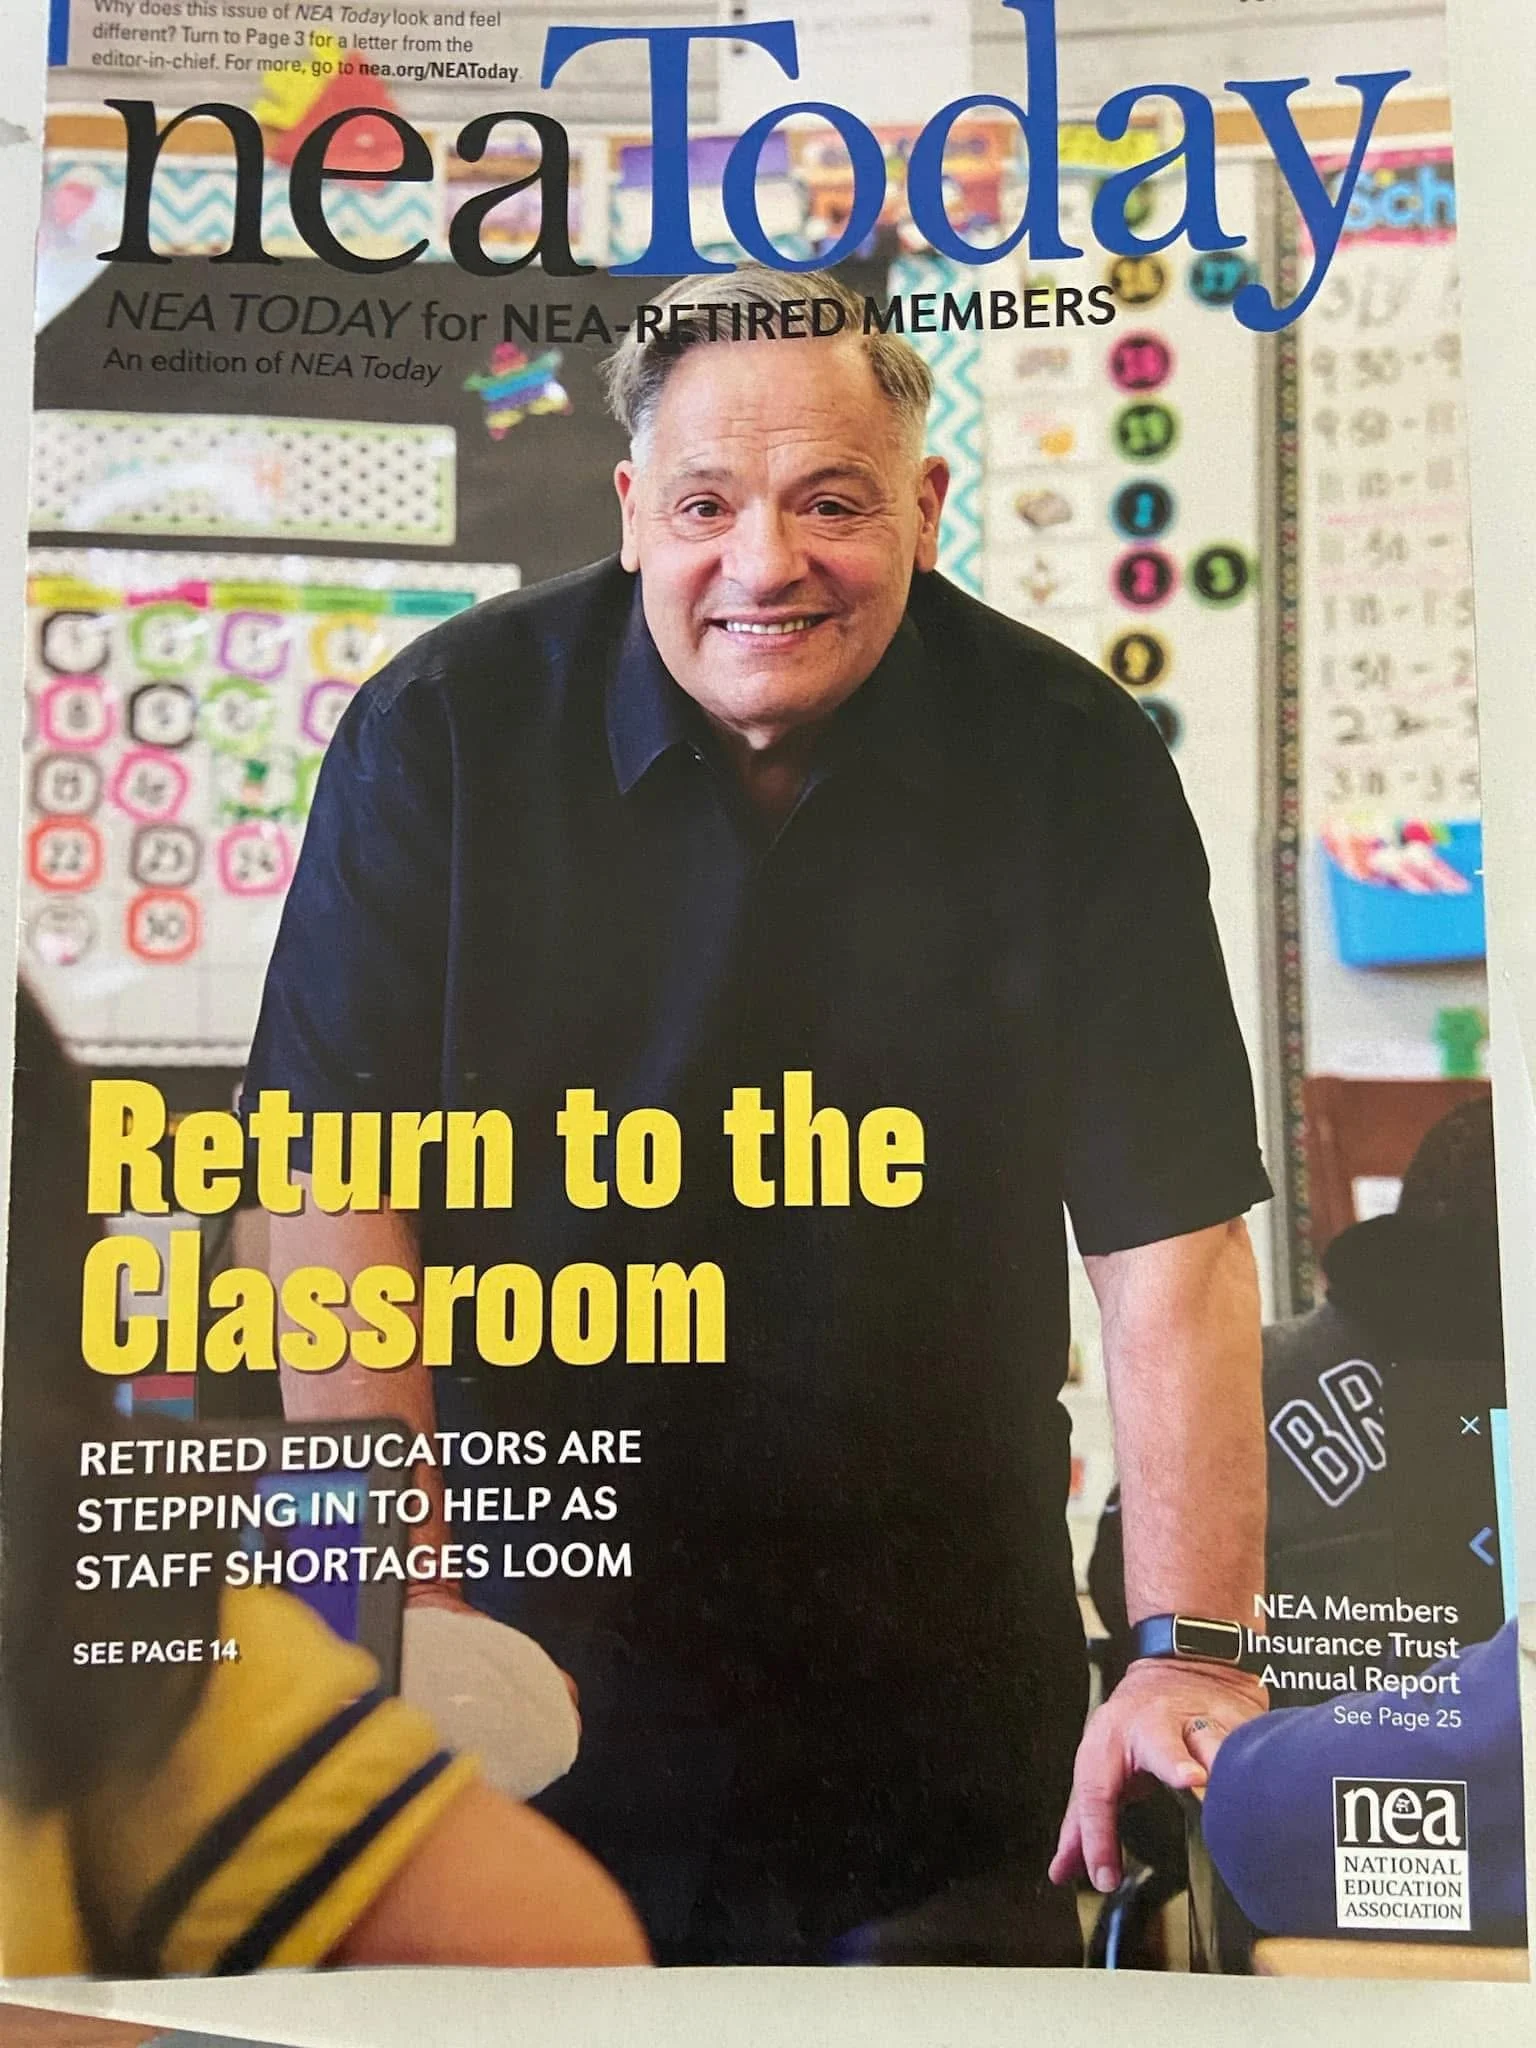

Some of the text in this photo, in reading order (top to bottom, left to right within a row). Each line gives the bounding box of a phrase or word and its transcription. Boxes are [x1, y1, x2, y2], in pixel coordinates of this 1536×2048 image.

[94, 0, 501, 28] Why does this issue of NEA Today look and feel
[92, 24, 473, 53] different? Turn to Page 3 for a letter from the
[91, 50, 220, 71] editor-in-chief.
[224, 53, 252, 71] For
[257, 57, 306, 75] more,
[311, 61, 332, 77] go
[339, 59, 354, 75] to
[106, 284, 1117, 345] NEA TODAY for NEA-RETIRED MEMBERS
[103, 348, 443, 388] An edition of NEA Today
[86, 1071, 927, 1216] Return to the
[80, 1229, 728, 1376] Classroom
[79, 1429, 643, 1477] RETIRED EDUCATORS ARE
[76, 1485, 618, 1534] STEPPING IN TO HELP AS
[75, 1541, 633, 1591] STAFF SHORTAGES LOOM
[1253, 1594, 1459, 1625] NEA Members
[72, 1638, 239, 1666] SEE PAGE 14
[1247, 1628, 1460, 1660] Insurance Trust
[1258, 1663, 1461, 1699] Annual Report
[1334, 1705, 1462, 1732] See Page 25
[1342, 1786, 1462, 1847] nea
[1344, 1856, 1462, 1876] NATIONAL
[1344, 1879, 1462, 1898] EDUCATION
[1345, 1901, 1462, 1920] ASSOCIATION
